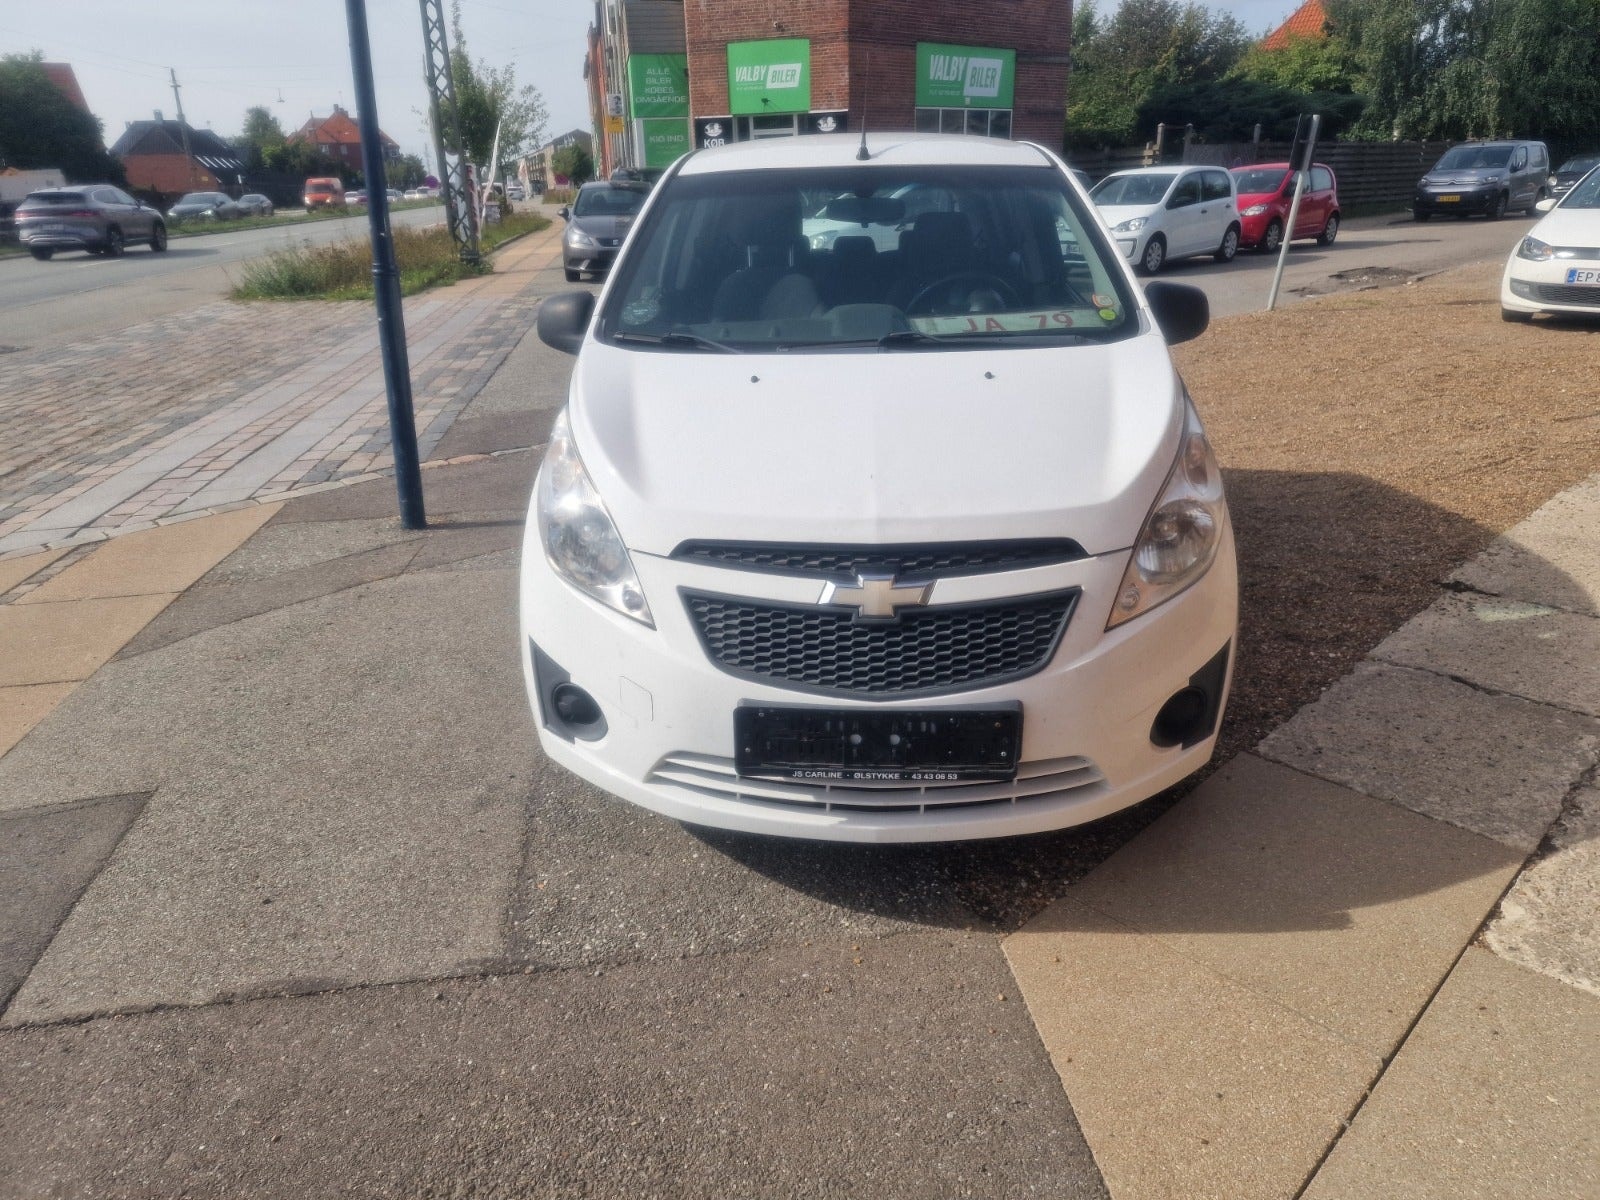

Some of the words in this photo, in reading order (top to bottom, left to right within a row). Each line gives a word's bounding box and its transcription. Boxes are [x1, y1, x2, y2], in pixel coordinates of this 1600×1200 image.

[646, 67, 670, 75] ALLE
[735, 64, 767, 83] VALBY
[771, 68, 798, 84] BILER
[929, 54, 967, 82] VALBY
[969, 66, 998, 89] BILER
[645, 77, 672, 85] BILER
[1576, 271, 1594, 282] EP
[792, 770, 803, 778] JS
[804, 771, 843, 779] CARLINE
[853, 772, 900, 780] ØLSTYKKE
